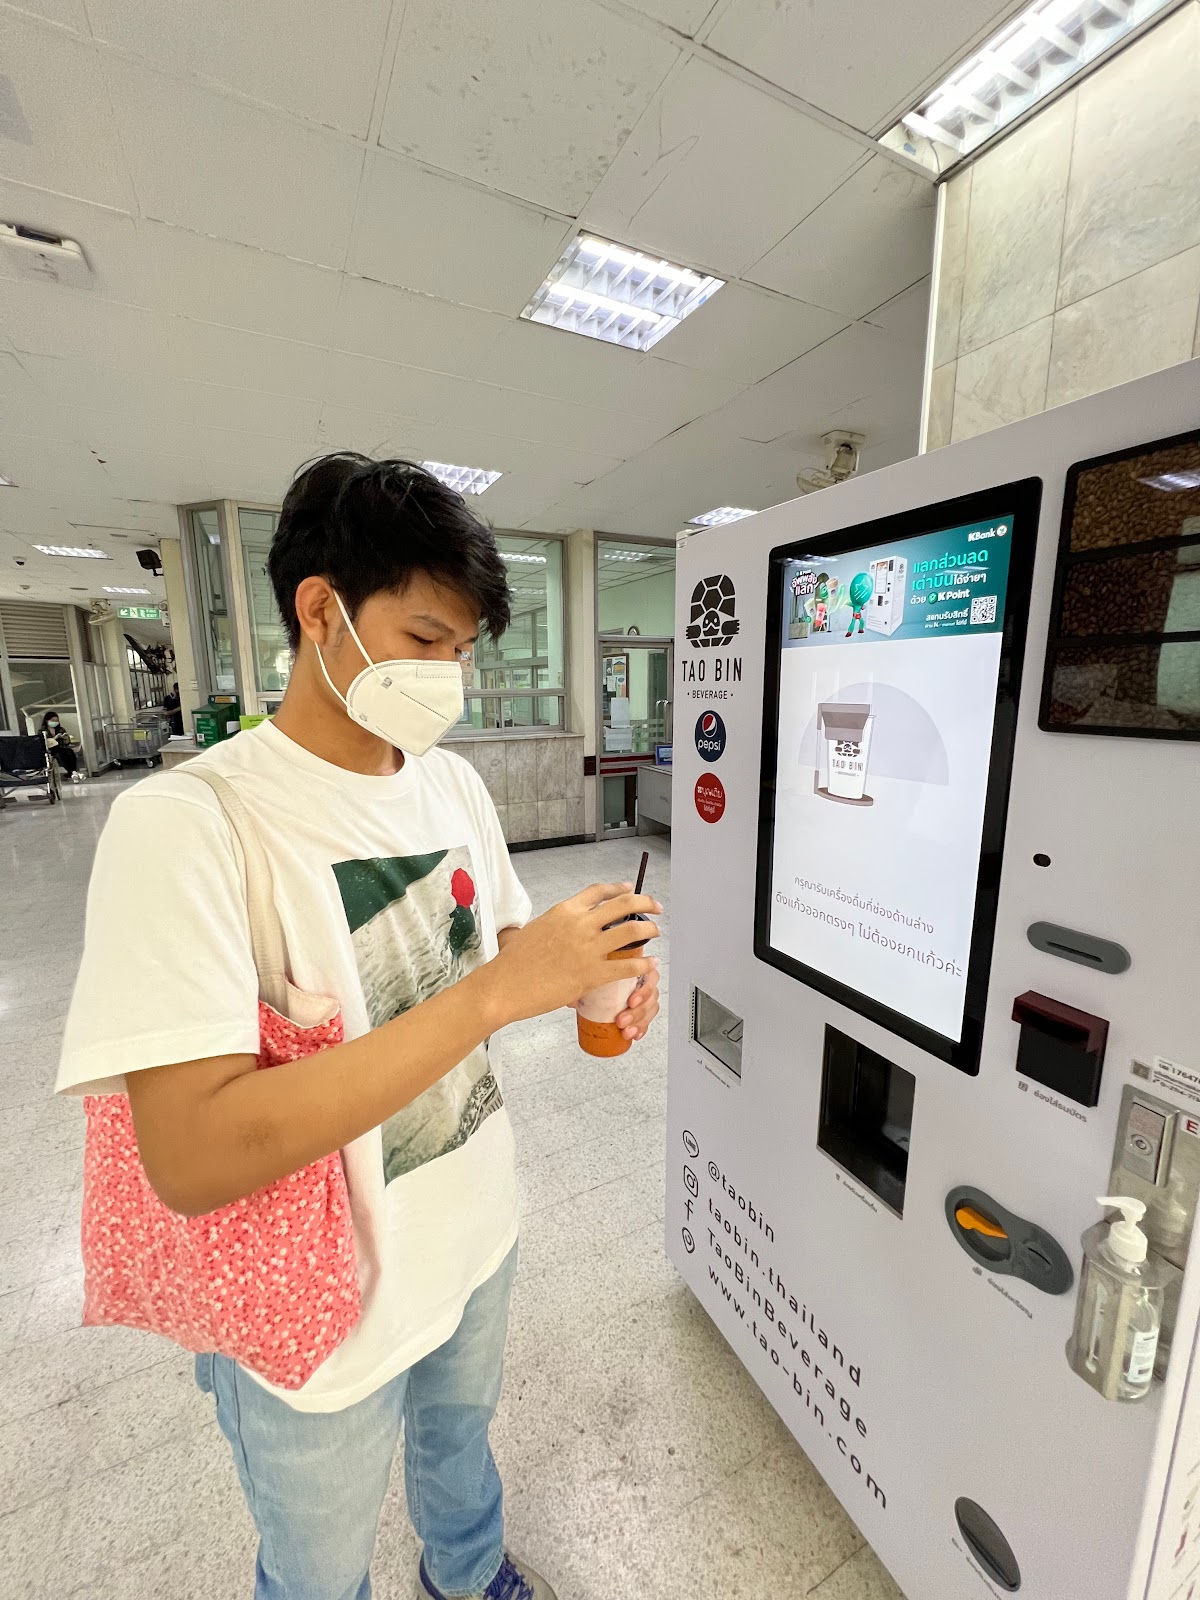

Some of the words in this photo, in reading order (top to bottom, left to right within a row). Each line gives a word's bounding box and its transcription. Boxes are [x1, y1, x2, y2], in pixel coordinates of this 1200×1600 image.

[967, 527, 996, 542] KBank
[913, 549, 989, 574] แลกส่วนลด
[910, 594, 927, 605] ด้วย
[937, 592, 946, 602] K
[946, 588, 971, 600] Point
[681, 659, 706, 682] TAO
[714, 657, 742, 682] BIN
[692, 689, 728, 700] BEVERAGE
[697, 738, 721, 752] pepsi
[832, 758, 846, 769] TAO
[848, 761, 864, 772] BIN
[707, 1160, 775, 1243] @taobin
[708, 1197, 861, 1388] taobin.thailand
[707, 1226, 868, 1438] TaoBinBeverage
[707, 1264, 887, 1510] www.tao-bin.com
